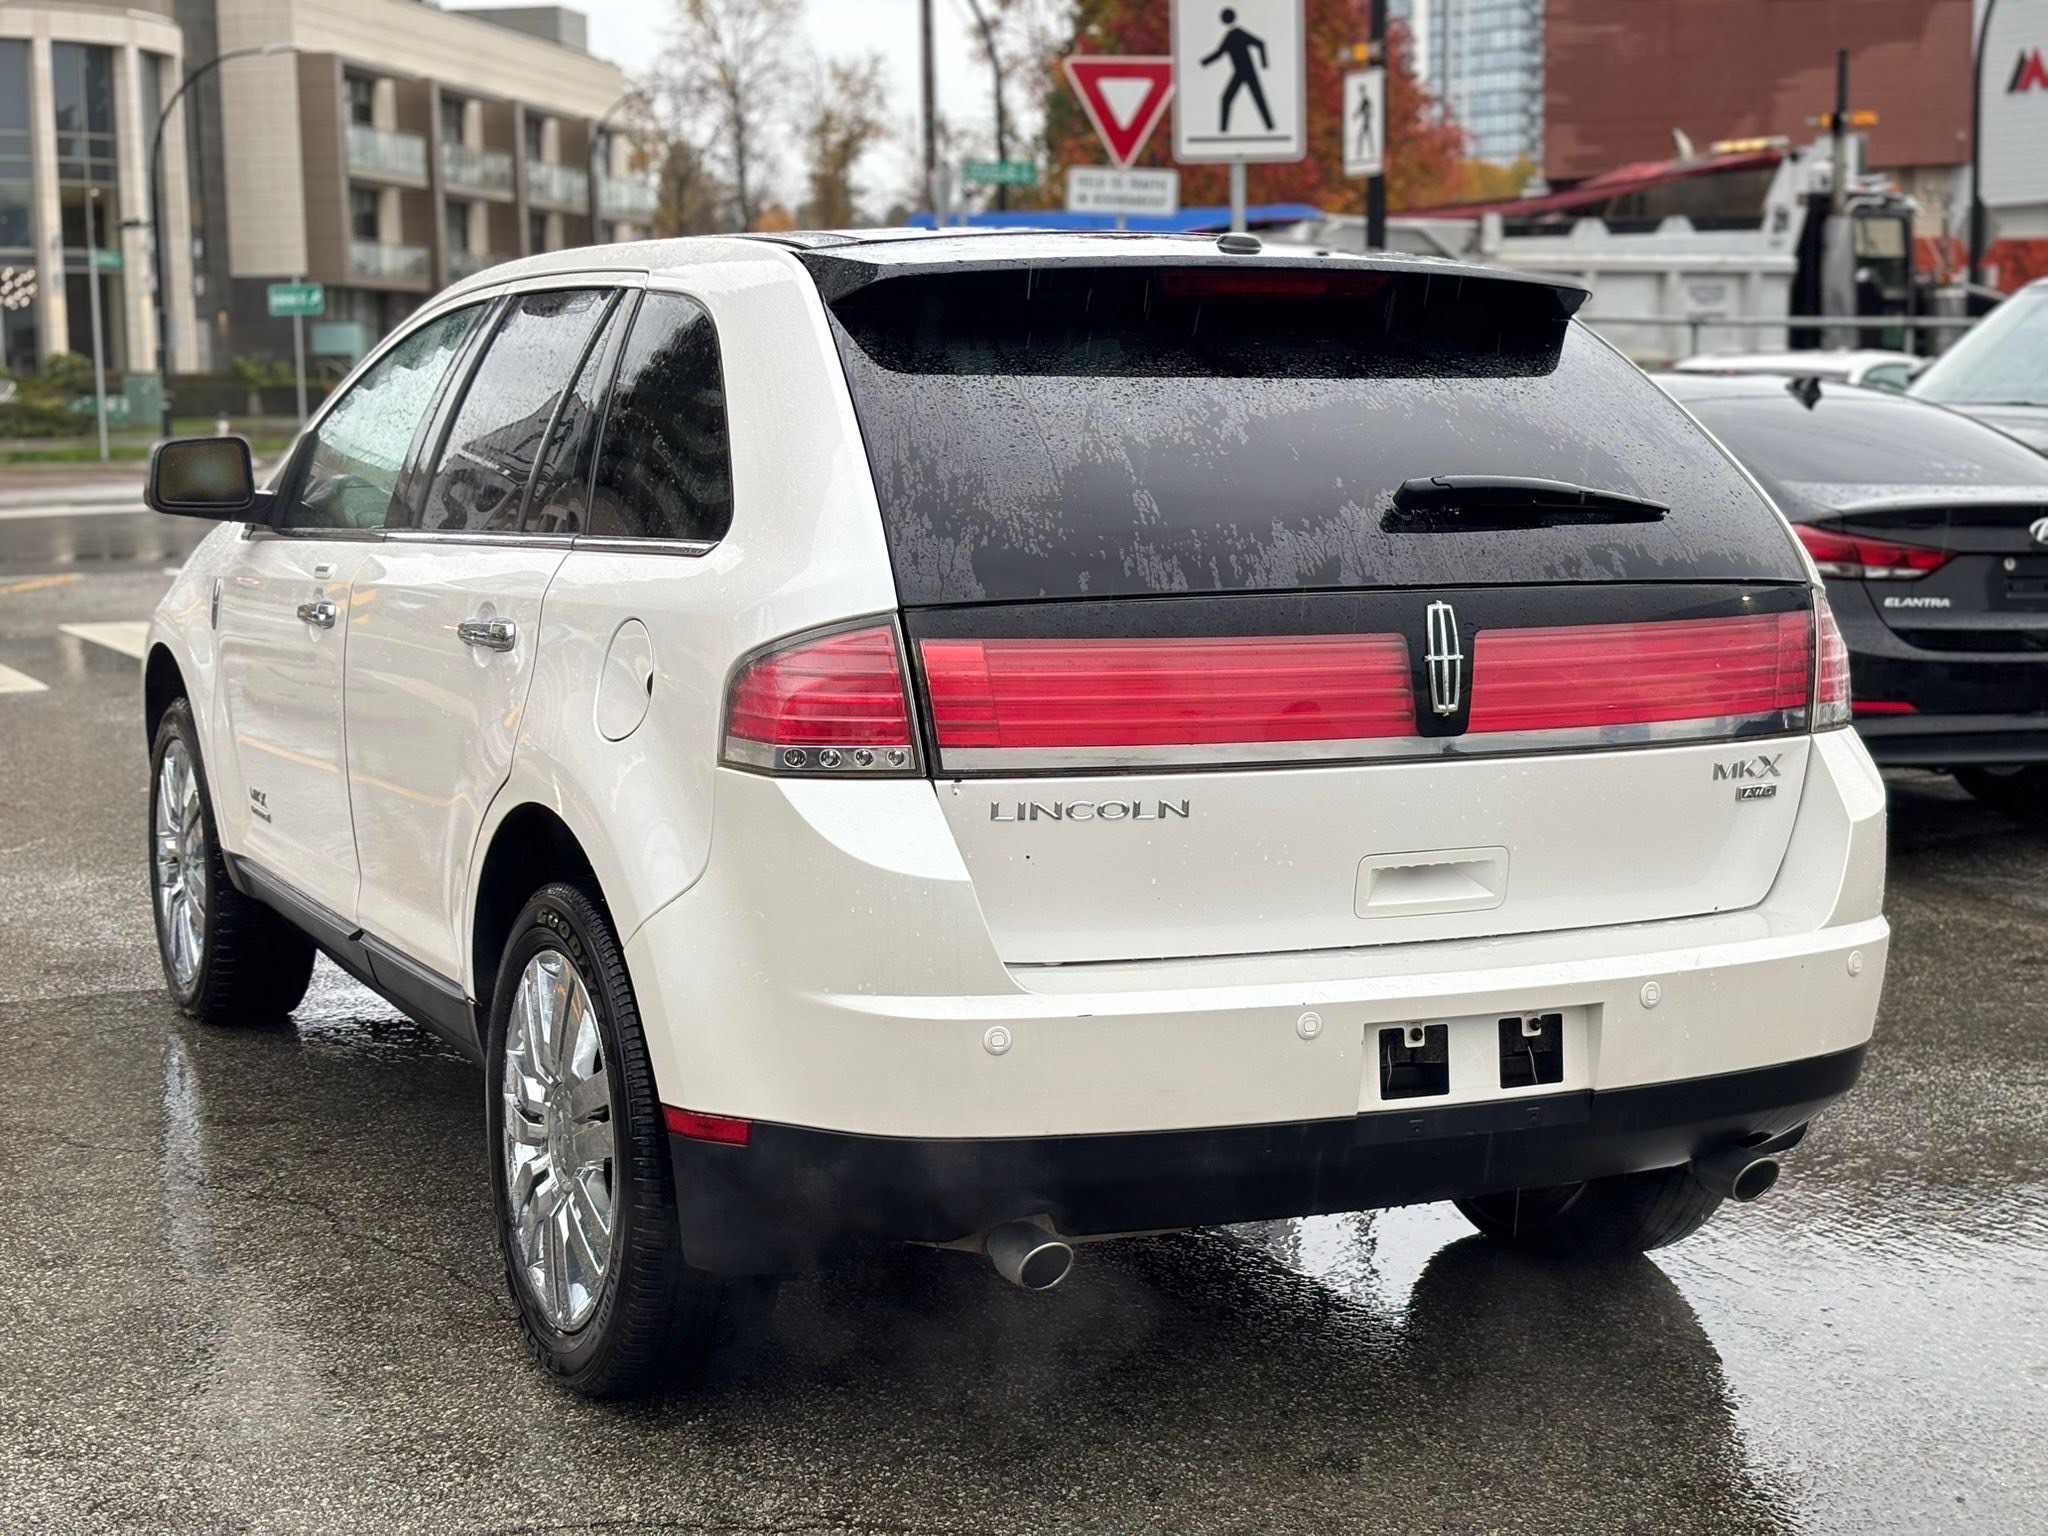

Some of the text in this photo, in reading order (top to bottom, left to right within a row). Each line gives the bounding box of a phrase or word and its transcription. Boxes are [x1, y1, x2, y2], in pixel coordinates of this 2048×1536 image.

[1883, 597, 1951, 608] ELANTRA
[1712, 753, 1783, 780] MKX
[990, 800, 1190, 821] LINCOLN
